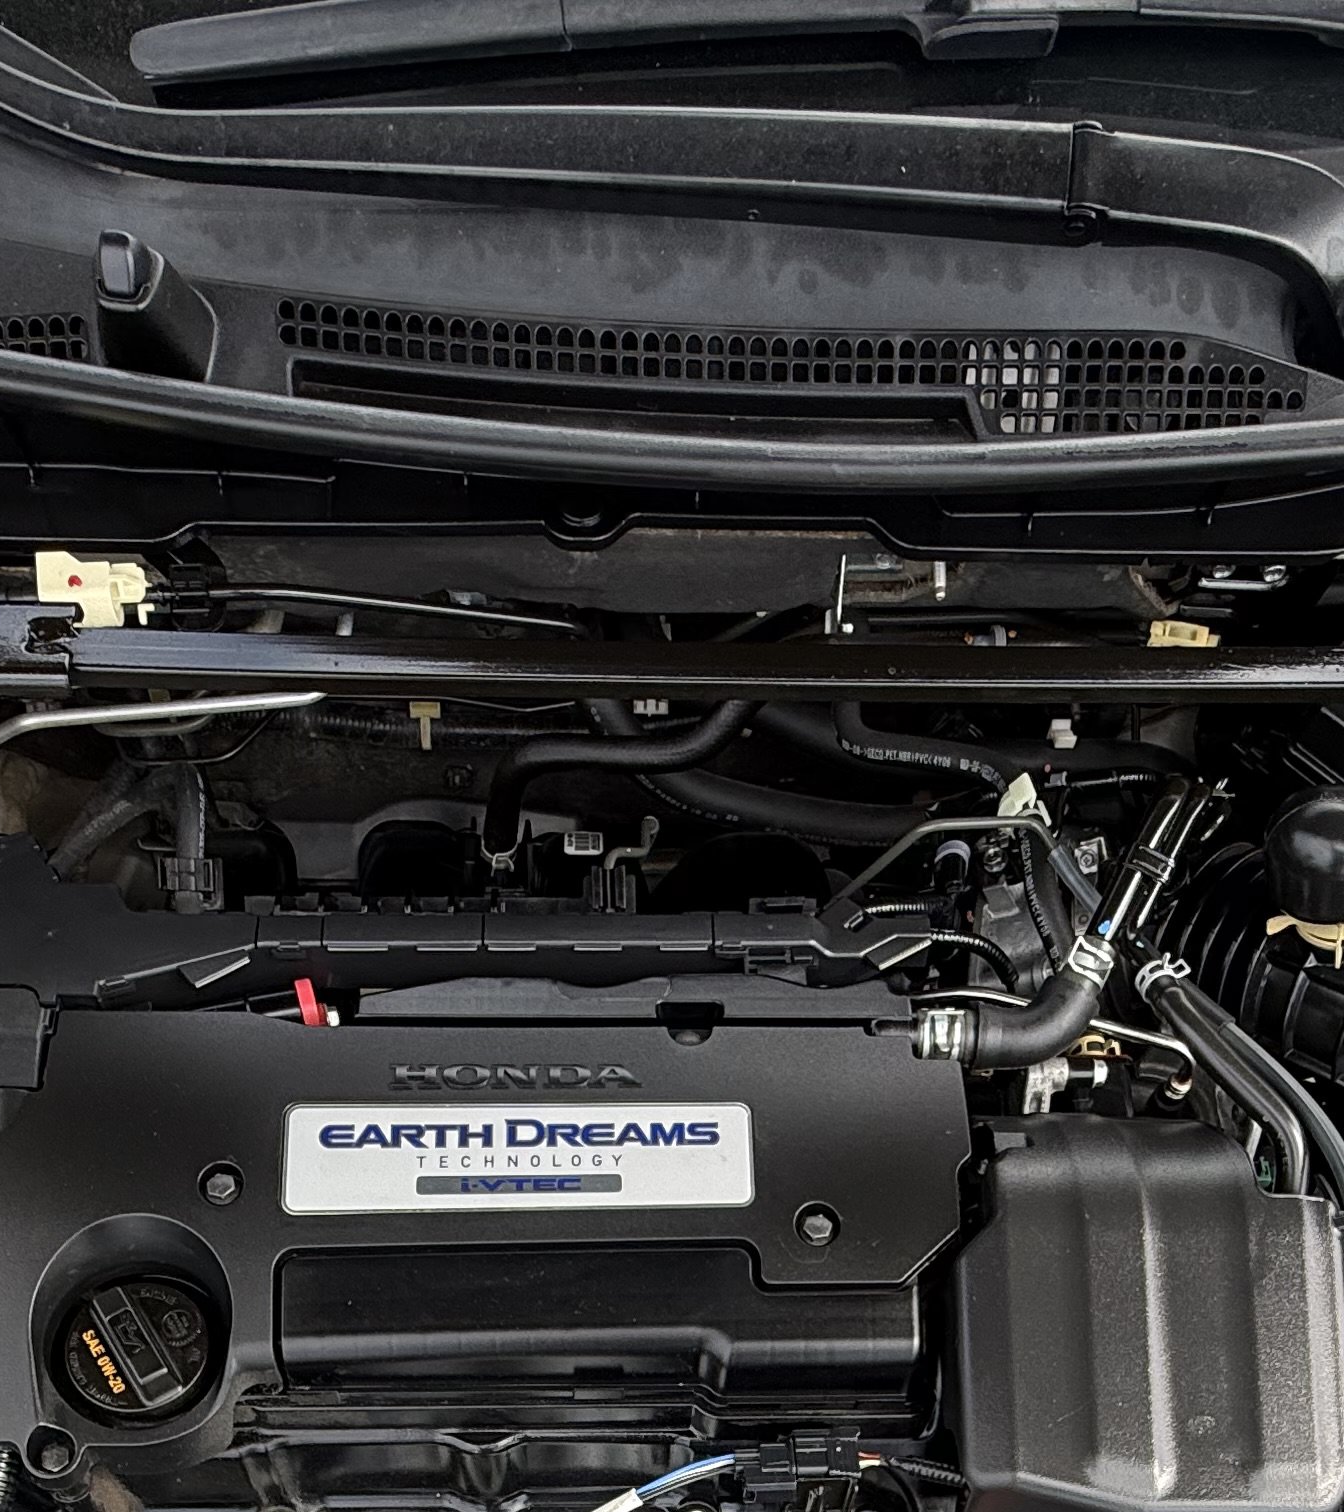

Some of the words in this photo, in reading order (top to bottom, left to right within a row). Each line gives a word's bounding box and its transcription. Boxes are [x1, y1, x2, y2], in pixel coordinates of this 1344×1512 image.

[389, 1063, 643, 1090] HONDA
[319, 1122, 494, 1149] EARTH
[505, 1119, 720, 1148] DREAMS
[416, 1154, 625, 1169] TECHNOLOGY
[460, 1176, 582, 1193] i-VTEC
[81, 1329, 104, 1358] SAE
[97, 1356, 126, 1394] 0W-20
